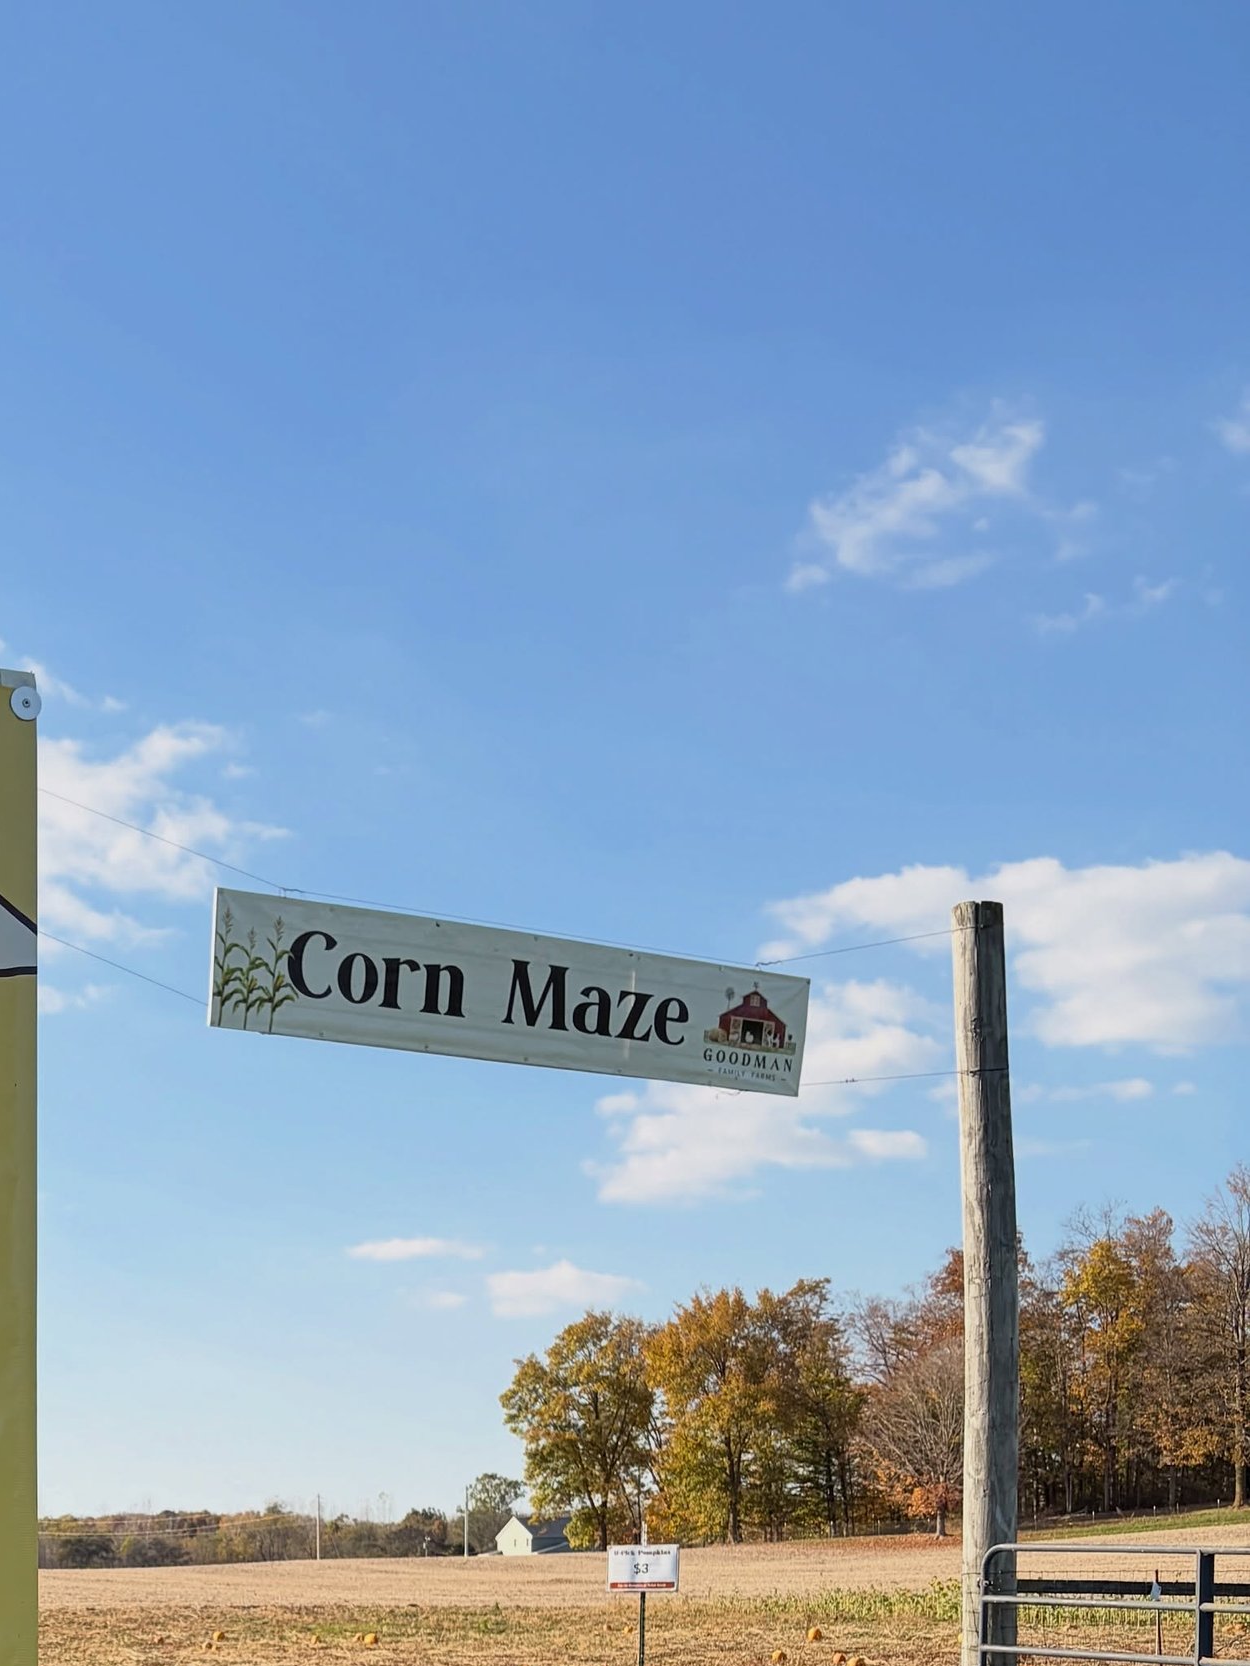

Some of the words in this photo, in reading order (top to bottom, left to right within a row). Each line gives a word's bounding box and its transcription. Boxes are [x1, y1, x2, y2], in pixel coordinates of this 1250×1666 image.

[287, 930, 466, 1018] Corn
[501, 958, 690, 1045] Maze
[703, 1047, 793, 1073] GOODMAN
[718, 1067, 746, 1078] FAMILY
[751, 1072, 776, 1082] FARMS
[633, 1562, 649, 1575] $3
